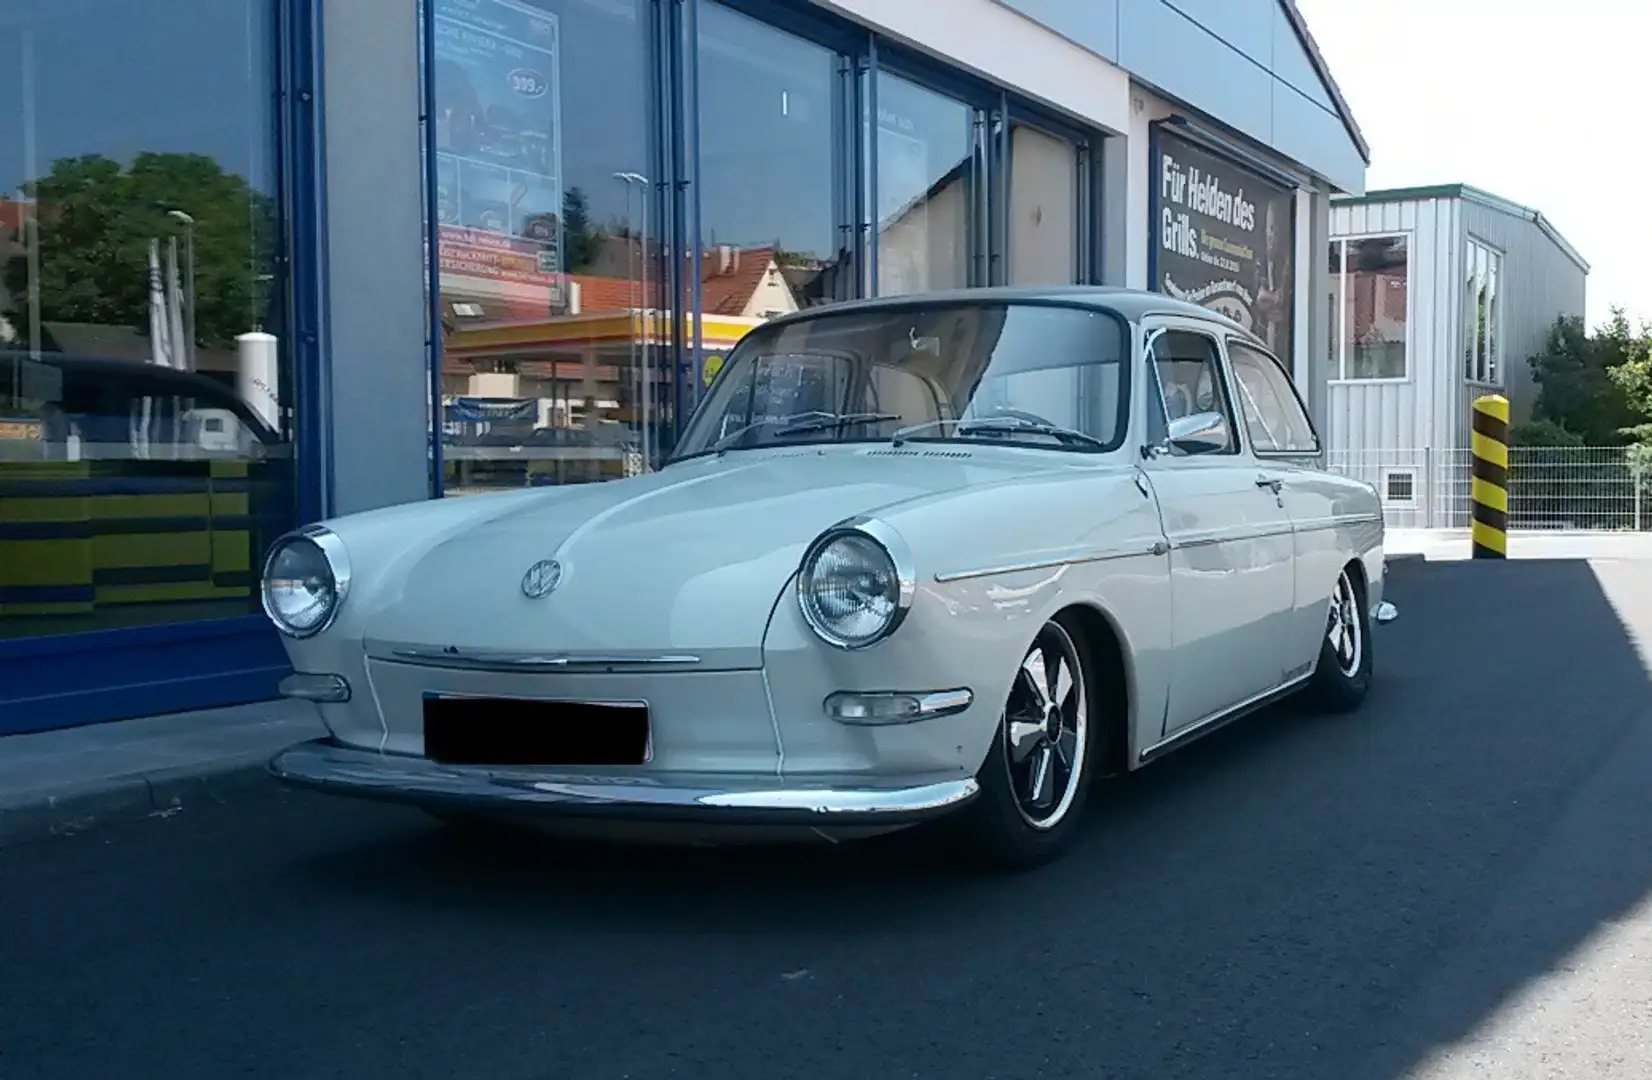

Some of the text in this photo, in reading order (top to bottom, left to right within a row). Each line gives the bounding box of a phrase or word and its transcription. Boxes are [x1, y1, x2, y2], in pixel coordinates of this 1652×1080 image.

[1162, 153, 1255, 232] Für Helden des
[1162, 206, 1199, 260] Grills.
